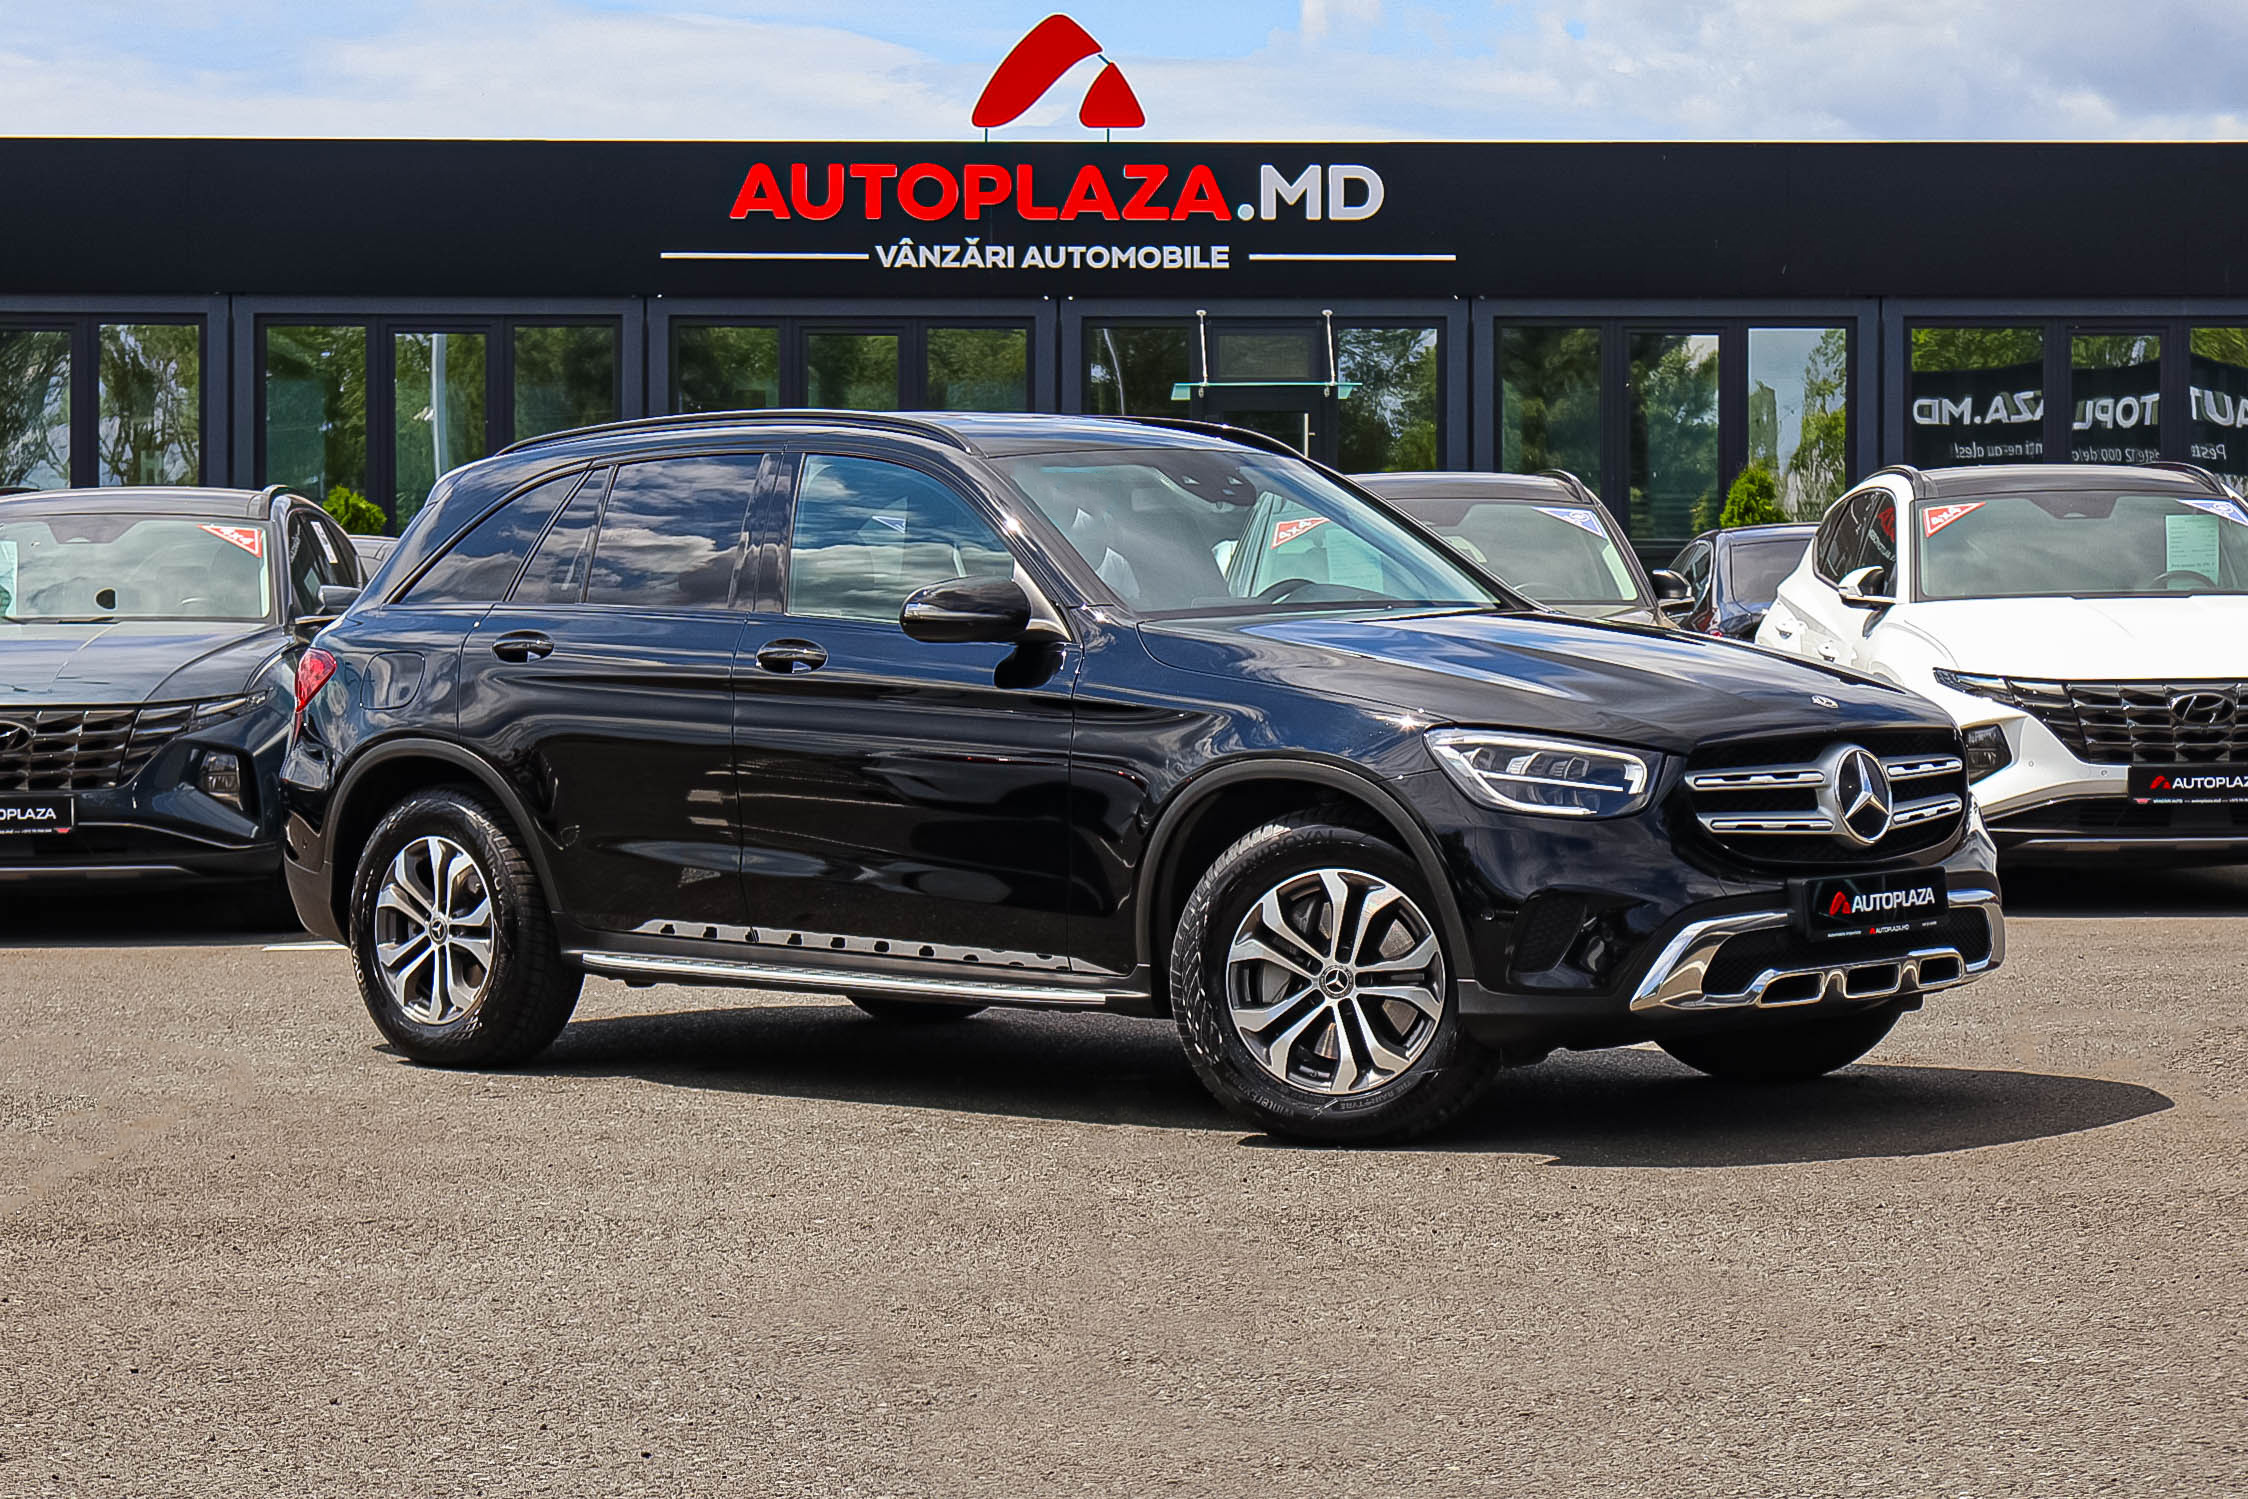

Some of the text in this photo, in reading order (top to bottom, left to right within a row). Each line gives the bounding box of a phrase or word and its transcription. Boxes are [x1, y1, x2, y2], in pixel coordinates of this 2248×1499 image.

[729, 162, 1385, 221] AUTOPLAZA.MD
[874, 236, 1230, 269] VÂNZĂRI AUTOMOBILE
[1851, 887, 1936, 914] AUTOPLAZA
